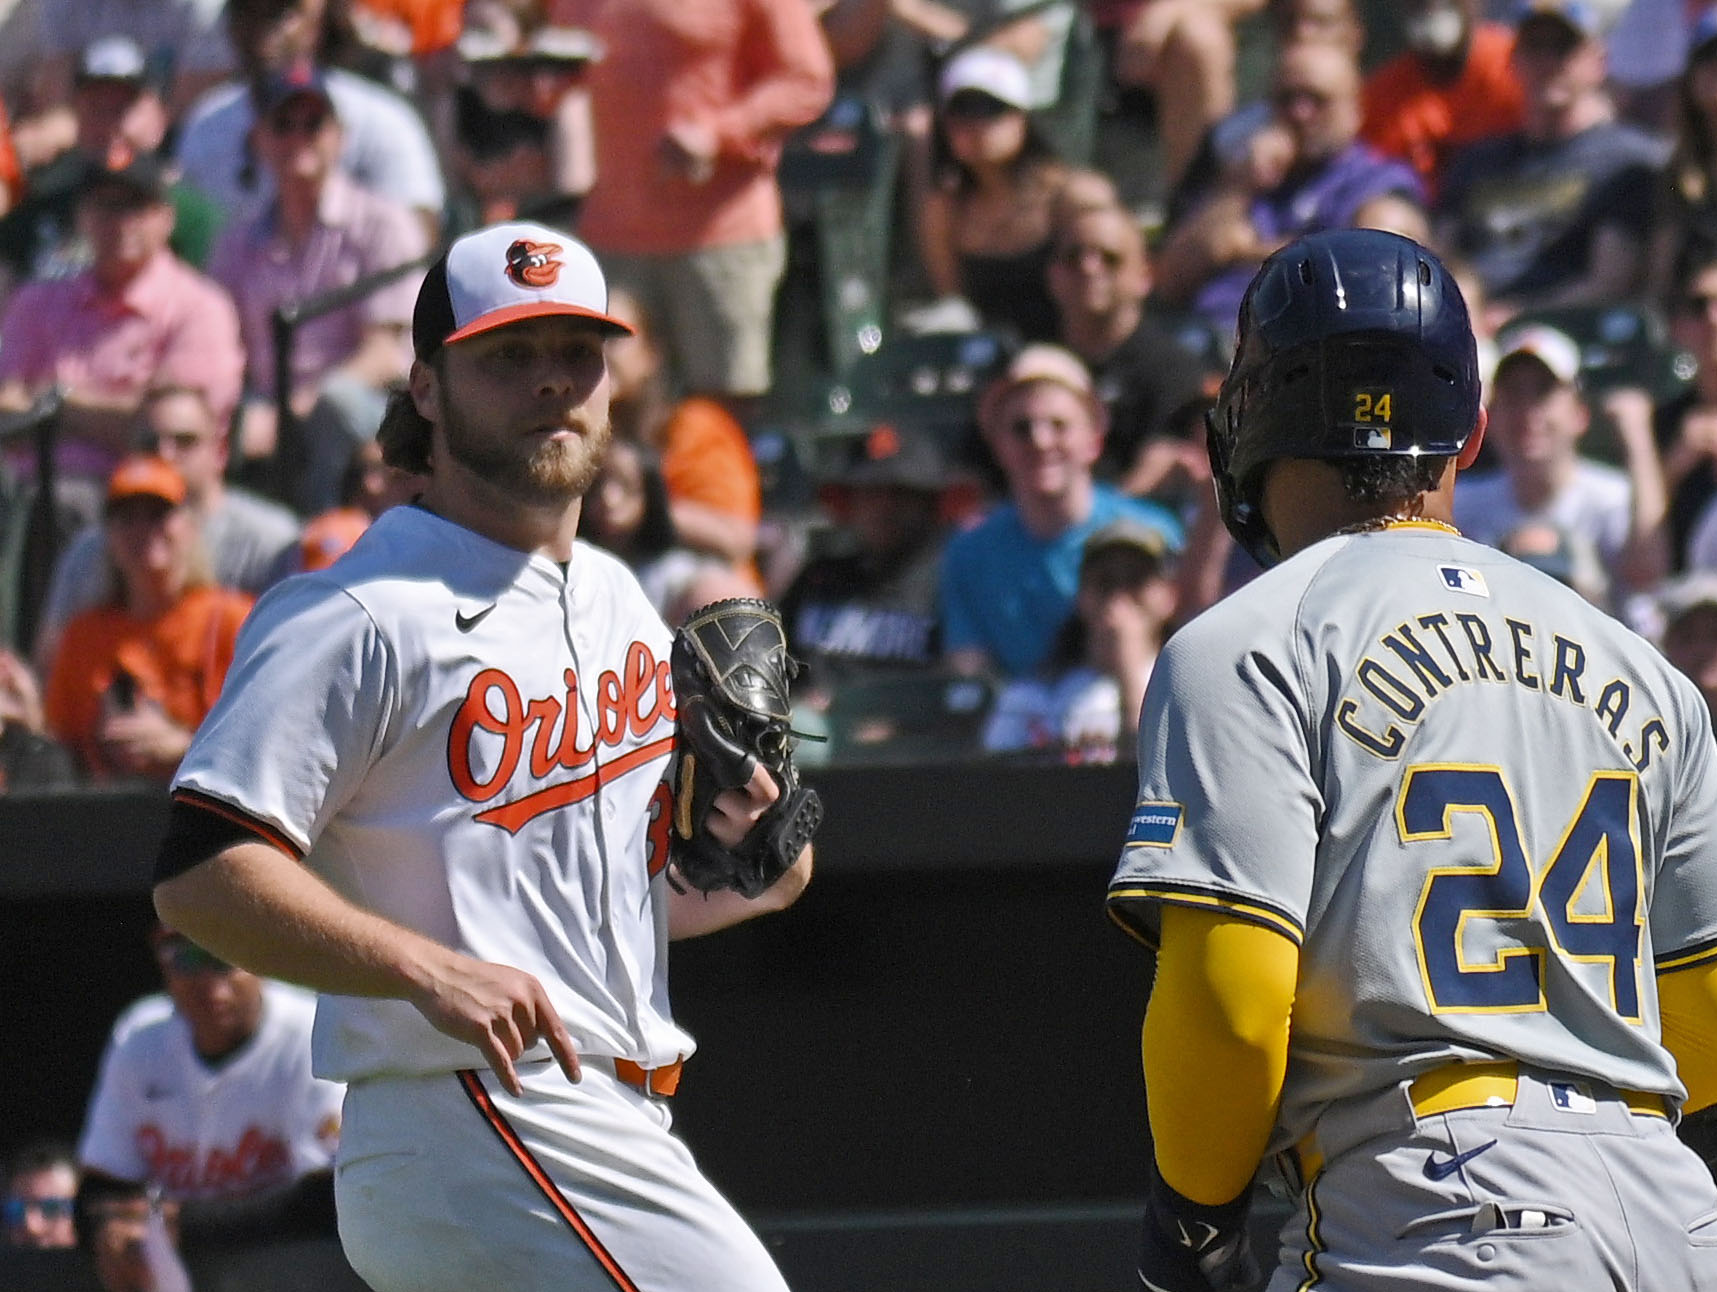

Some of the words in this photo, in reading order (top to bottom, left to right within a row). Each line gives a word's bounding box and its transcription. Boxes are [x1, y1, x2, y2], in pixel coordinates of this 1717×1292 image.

[1354, 393, 1391, 422] 24
[447, 640, 678, 802] Oriole
[1335, 611, 1671, 777] CONTRERAS
[1395, 761, 1646, 1026] 24
